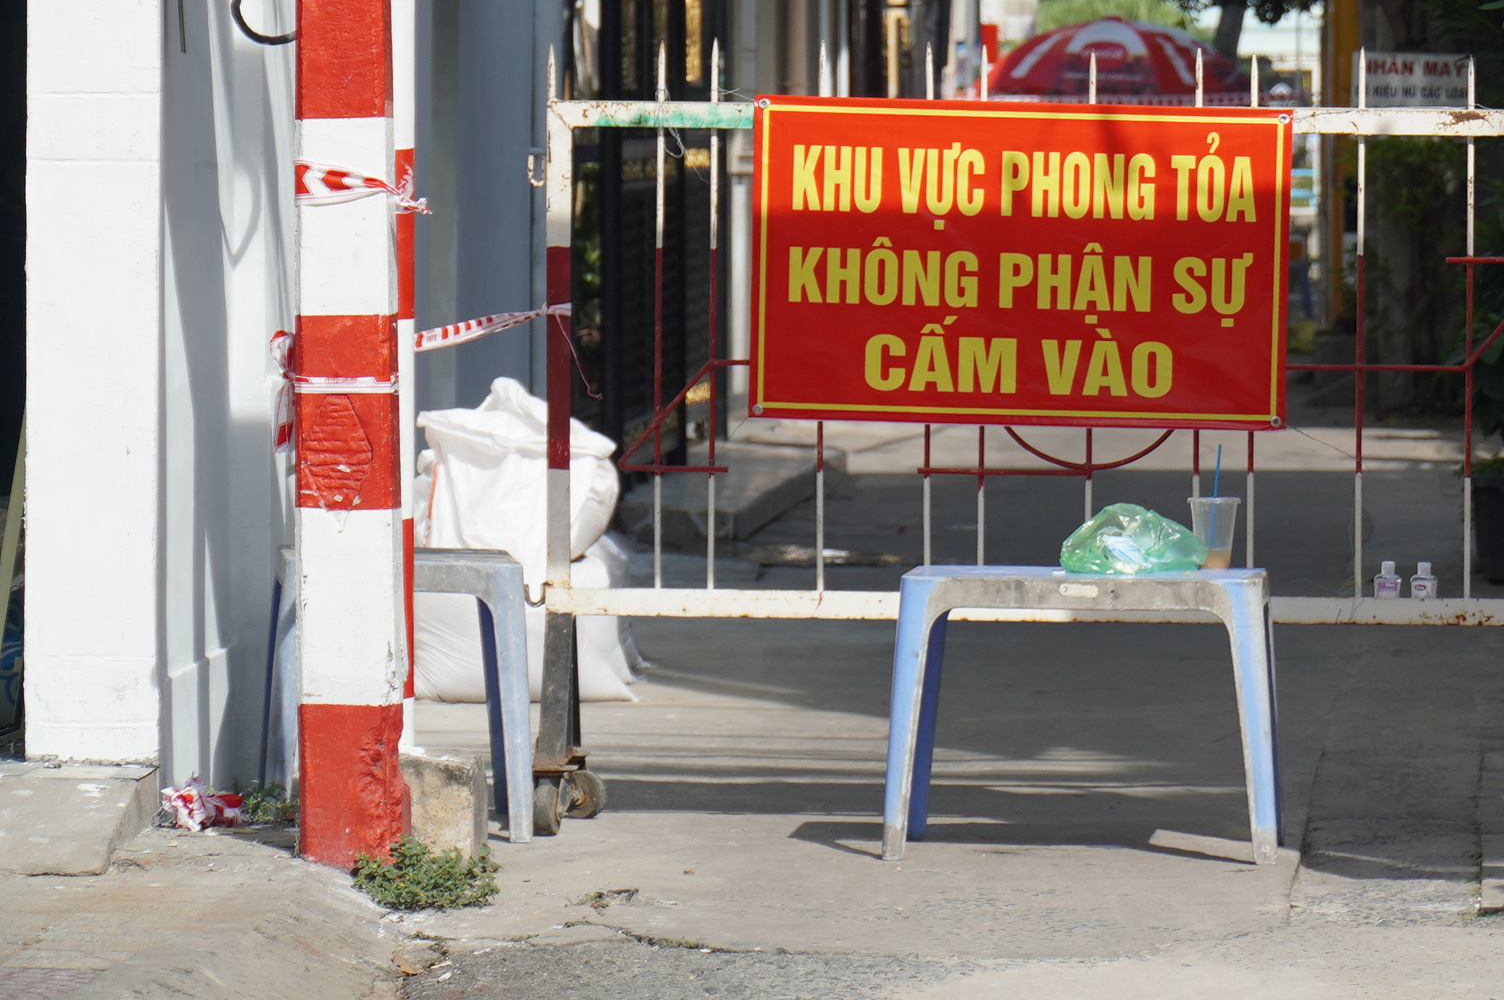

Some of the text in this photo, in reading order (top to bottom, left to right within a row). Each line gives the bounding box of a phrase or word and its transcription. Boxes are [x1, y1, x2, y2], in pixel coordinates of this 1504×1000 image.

[792, 132, 1256, 230] KHU VỰC PHONG TỎA
[788, 236, 1254, 327] KHÔNG PHẬN SỰ
[864, 315, 1173, 399] CẤM VÀO
